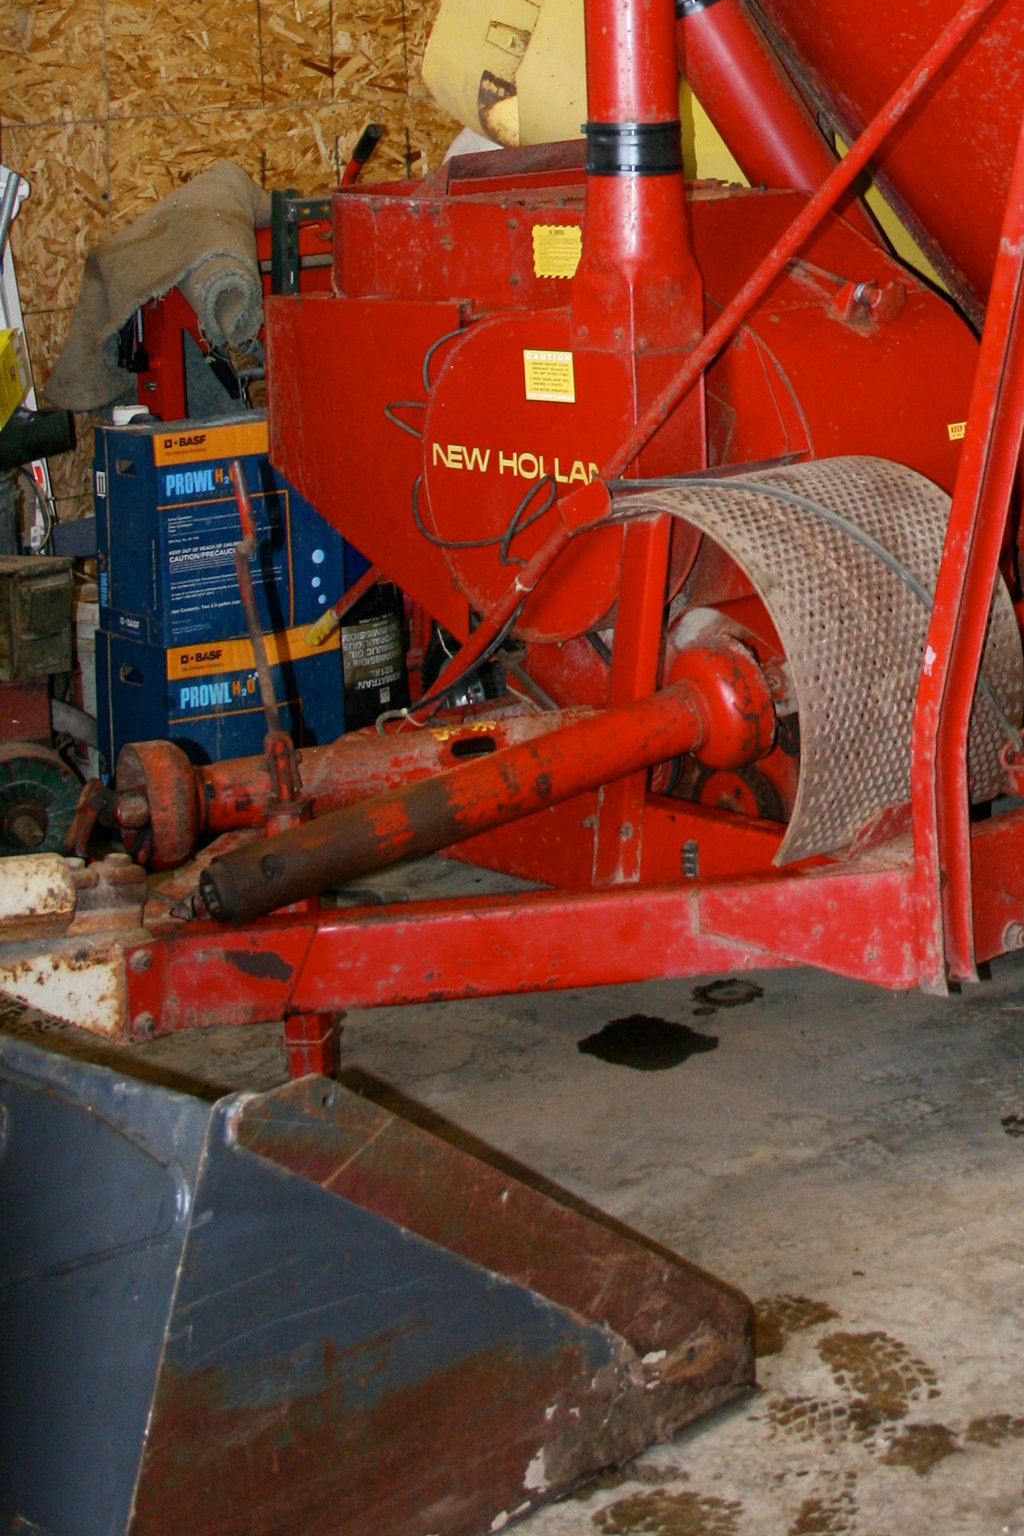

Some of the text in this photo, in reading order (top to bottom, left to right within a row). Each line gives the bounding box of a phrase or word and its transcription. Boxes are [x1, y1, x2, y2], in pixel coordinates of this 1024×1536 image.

[526, 351, 571, 362] CAUTION
[179, 435, 207, 447] BASF
[432, 443, 601, 486] NEW HOLLAN
[166, 469, 214, 497] PROWL
[196, 650, 223, 663] BASF
[180, 681, 232, 710] PROWL
